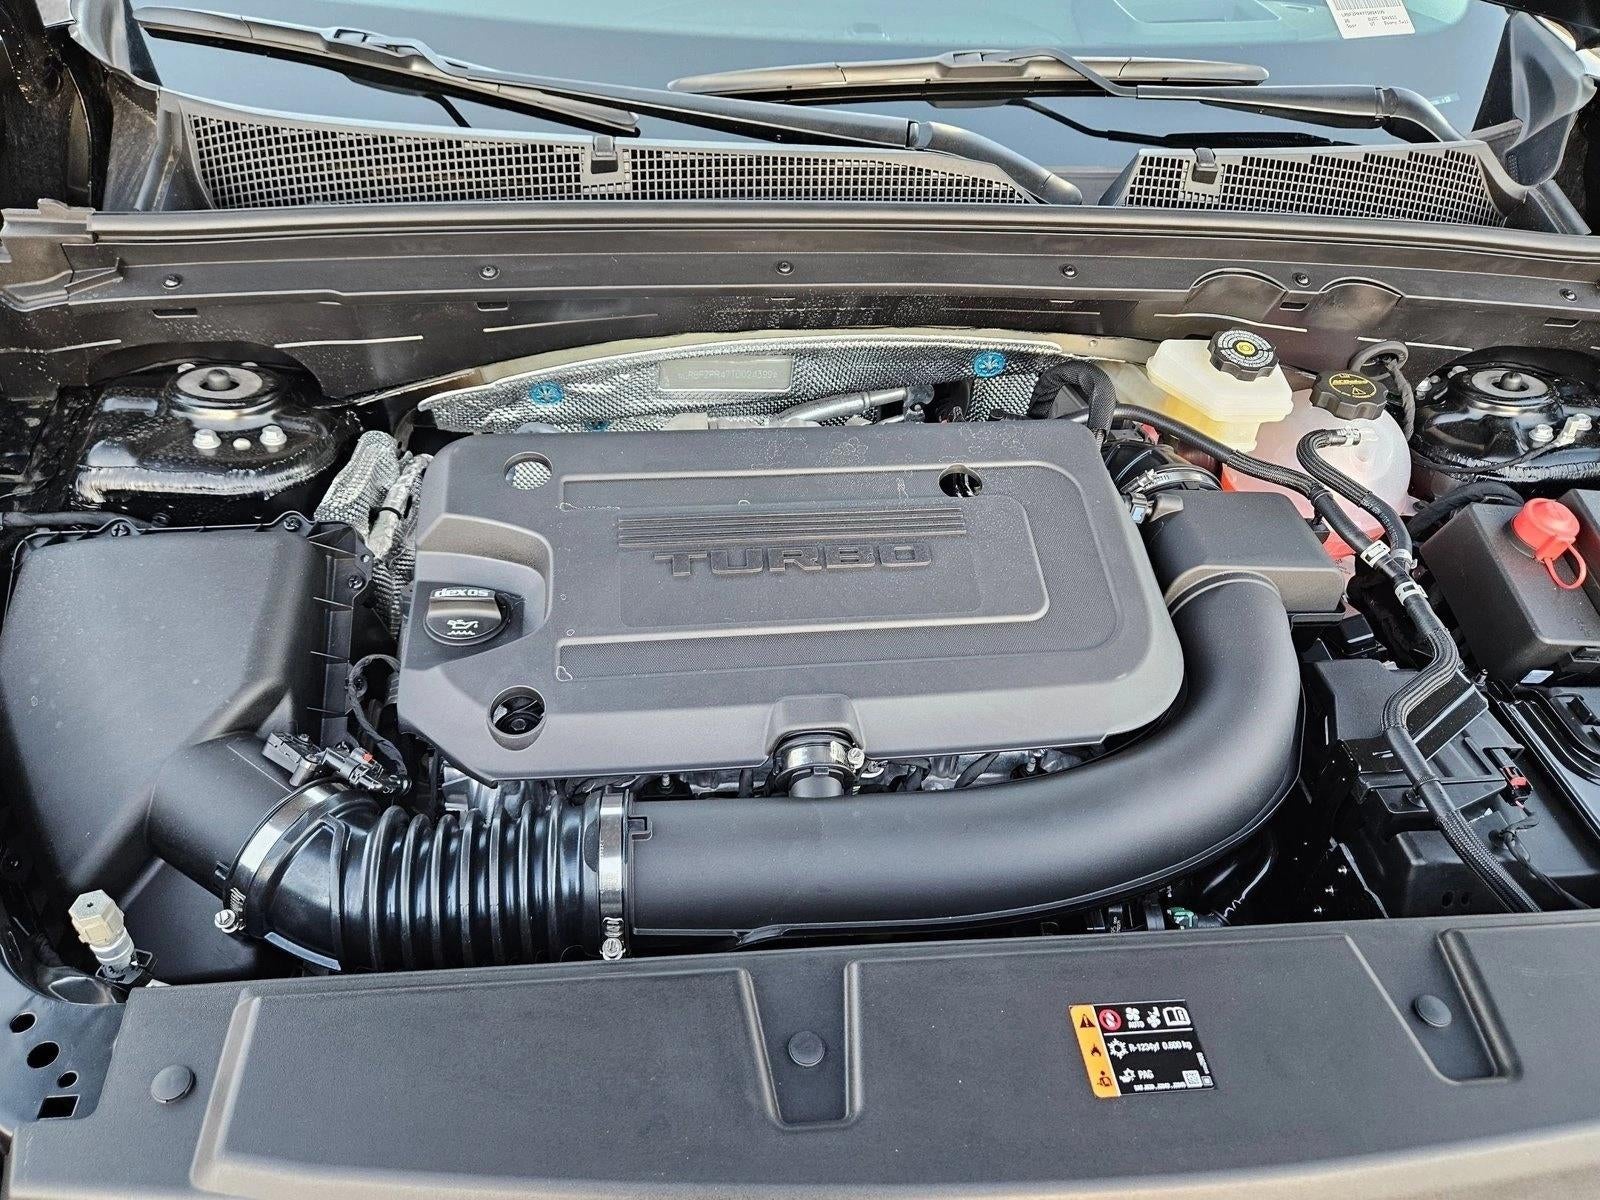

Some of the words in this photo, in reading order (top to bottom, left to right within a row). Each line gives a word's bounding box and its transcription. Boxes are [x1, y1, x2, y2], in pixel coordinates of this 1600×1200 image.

[653, 544, 932, 577] TURBO
[434, 588, 490, 598] dexos
[1137, 1069, 1155, 1080] PAG
